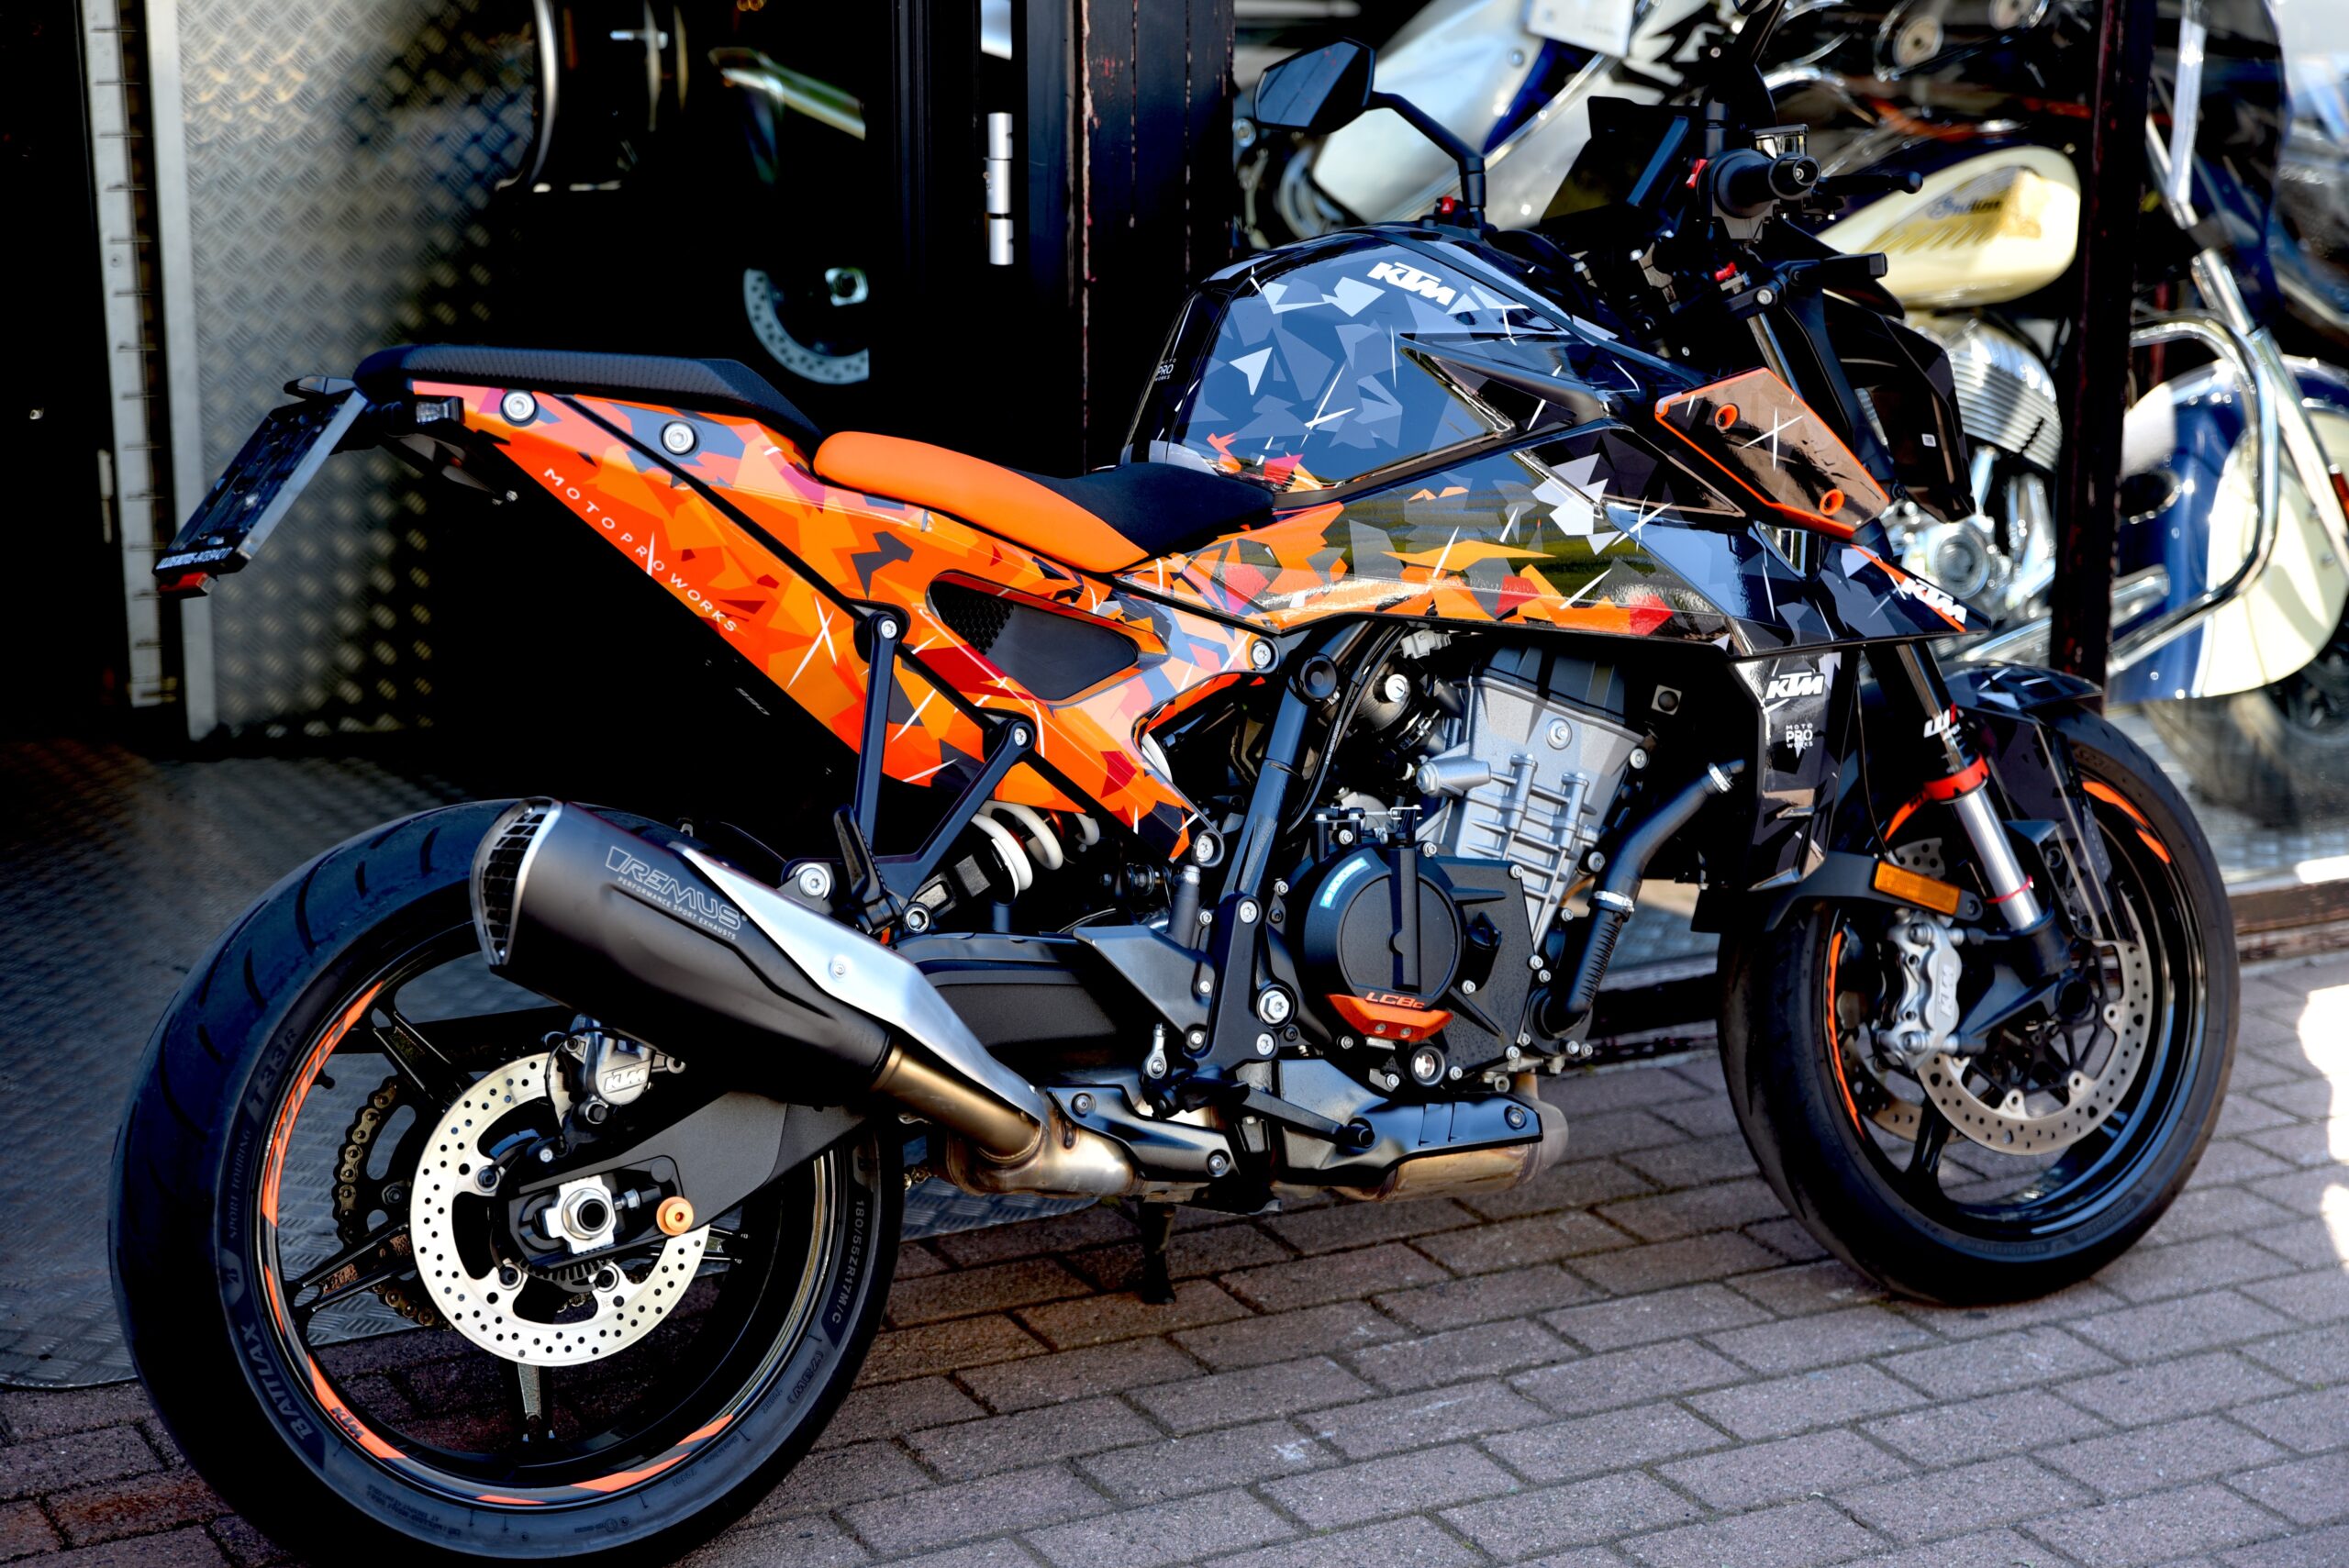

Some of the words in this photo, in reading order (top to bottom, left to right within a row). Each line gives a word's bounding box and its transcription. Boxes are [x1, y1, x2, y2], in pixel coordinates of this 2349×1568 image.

[1367, 261, 1456, 306] KTM
[544, 468, 616, 529] MOTO
[620, 532, 665, 572] PRO
[671, 573, 737, 632] WORKS
[1901, 576, 1966, 624] KTM
[1765, 672, 1824, 699] KTM
[1786, 729, 1813, 743] PRO
[618, 875, 671, 907] PERFORMANCE
[673, 904, 697, 920] SPORT
[698, 917, 737, 940] EXHAUSTS
[621, 858, 741, 930] REMUS
[604, 1064, 646, 1092] KTM
[240, 1322, 314, 1440] BATTLAX
[331, 1407, 365, 1439] KTM
